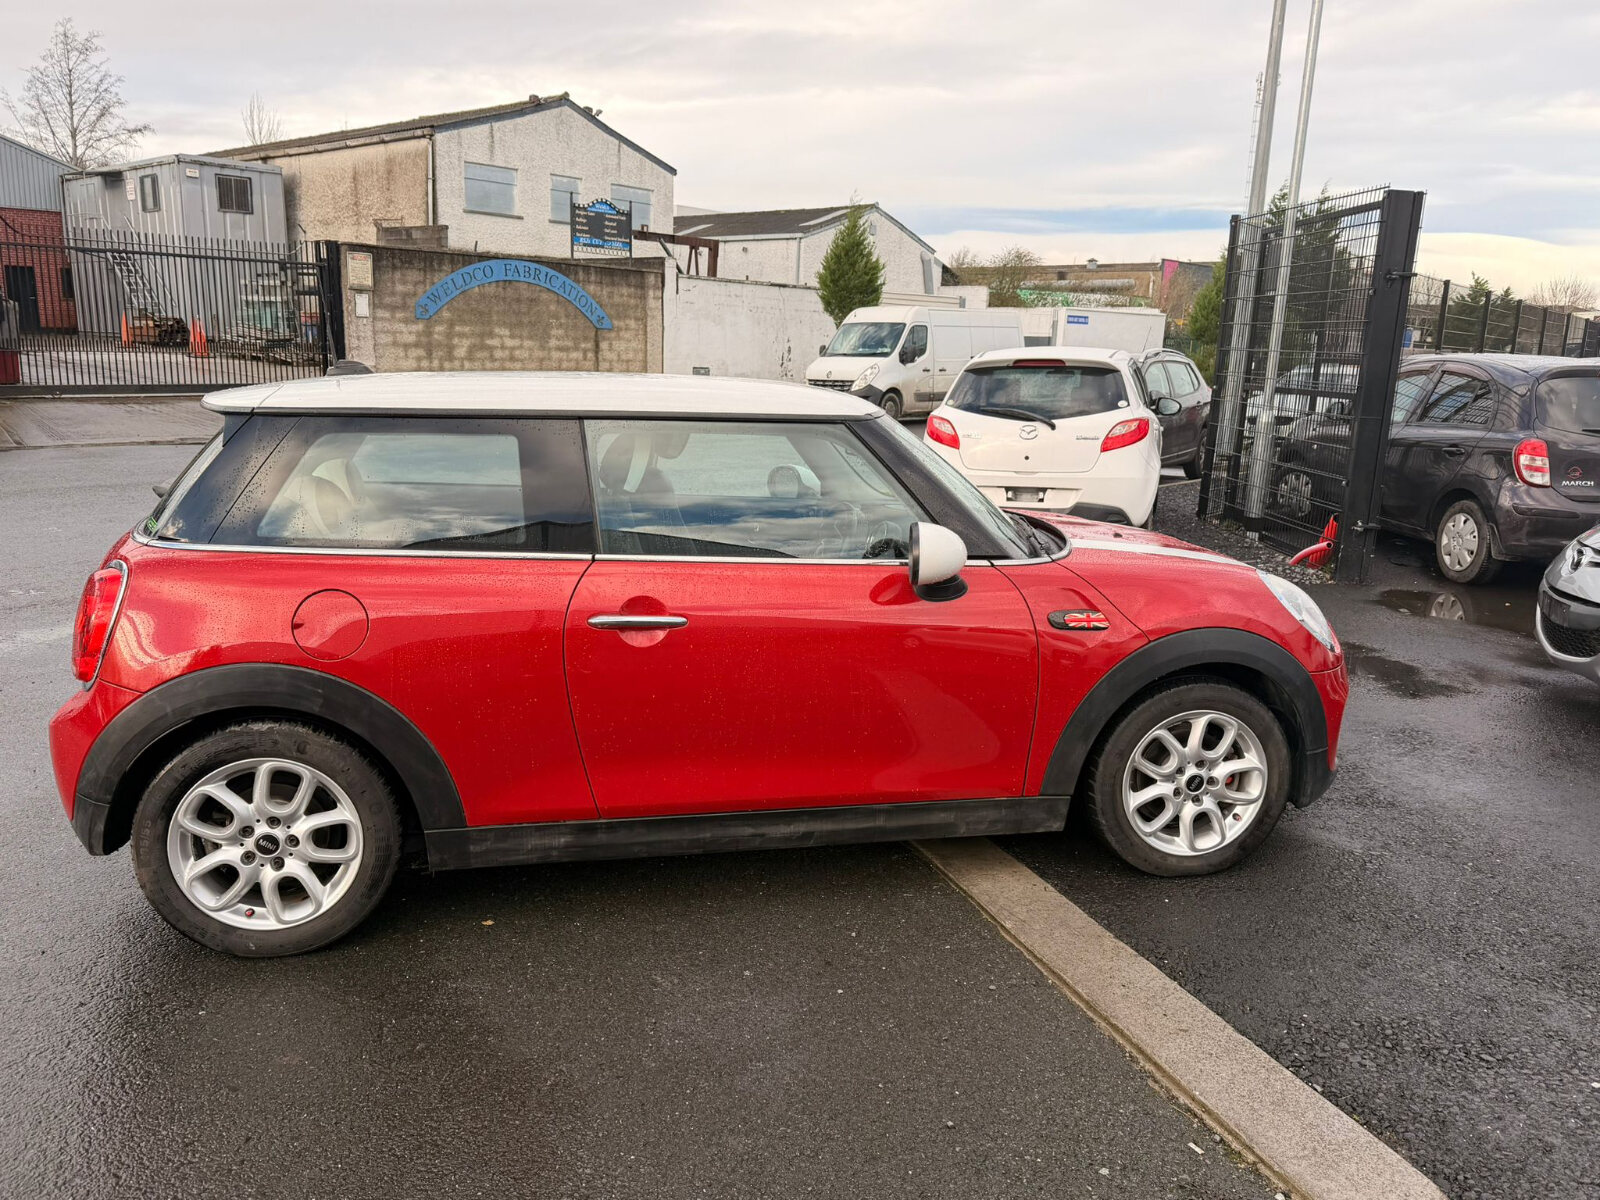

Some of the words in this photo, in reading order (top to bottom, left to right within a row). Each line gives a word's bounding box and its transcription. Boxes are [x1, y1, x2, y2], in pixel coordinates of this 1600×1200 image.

[427, 264, 494, 307] WELDCO
[503, 263, 598, 317] FABRICATION
[258, 838, 277, 851] MINI
